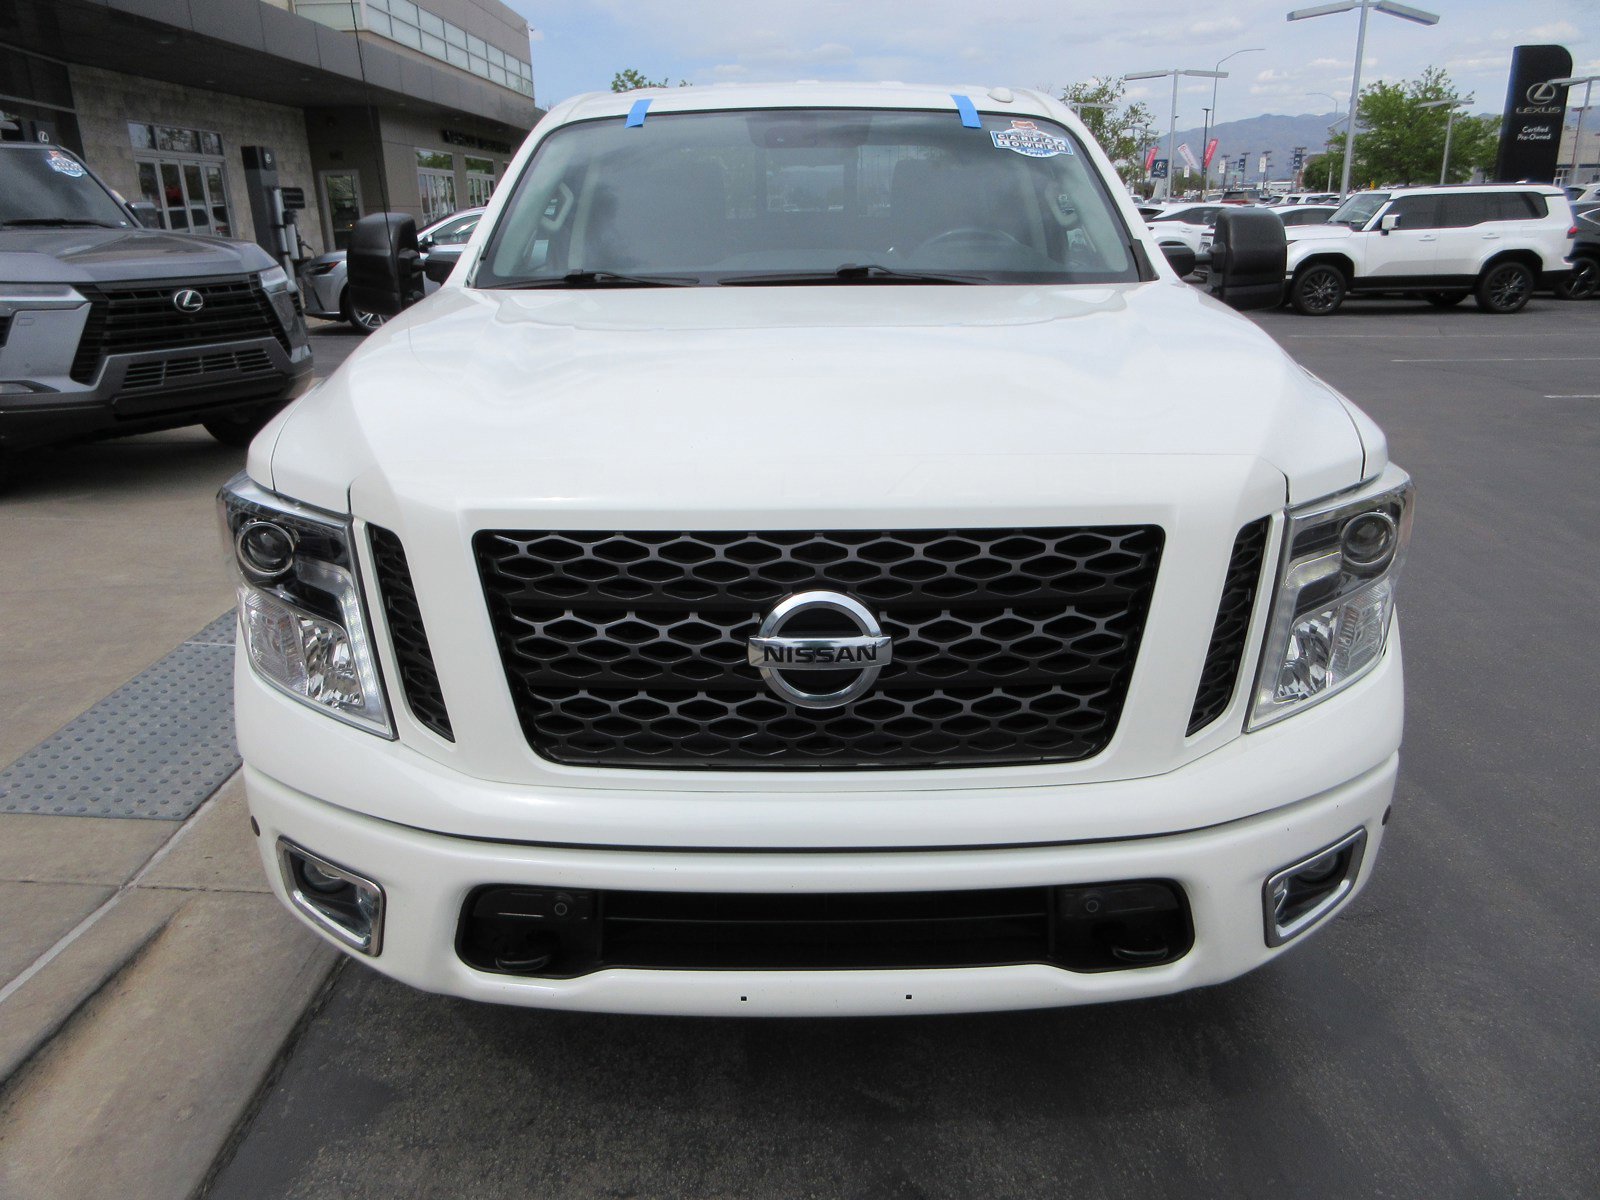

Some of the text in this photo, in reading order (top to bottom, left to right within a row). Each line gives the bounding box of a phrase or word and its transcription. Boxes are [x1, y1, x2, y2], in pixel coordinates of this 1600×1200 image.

[1516, 106, 1561, 114] LEXUS
[1522, 125, 1549, 133] Certified
[997, 133, 1065, 146] CARFAX
[1011, 141, 1067, 152] OWNER
[764, 645, 877, 663] NISSAN
